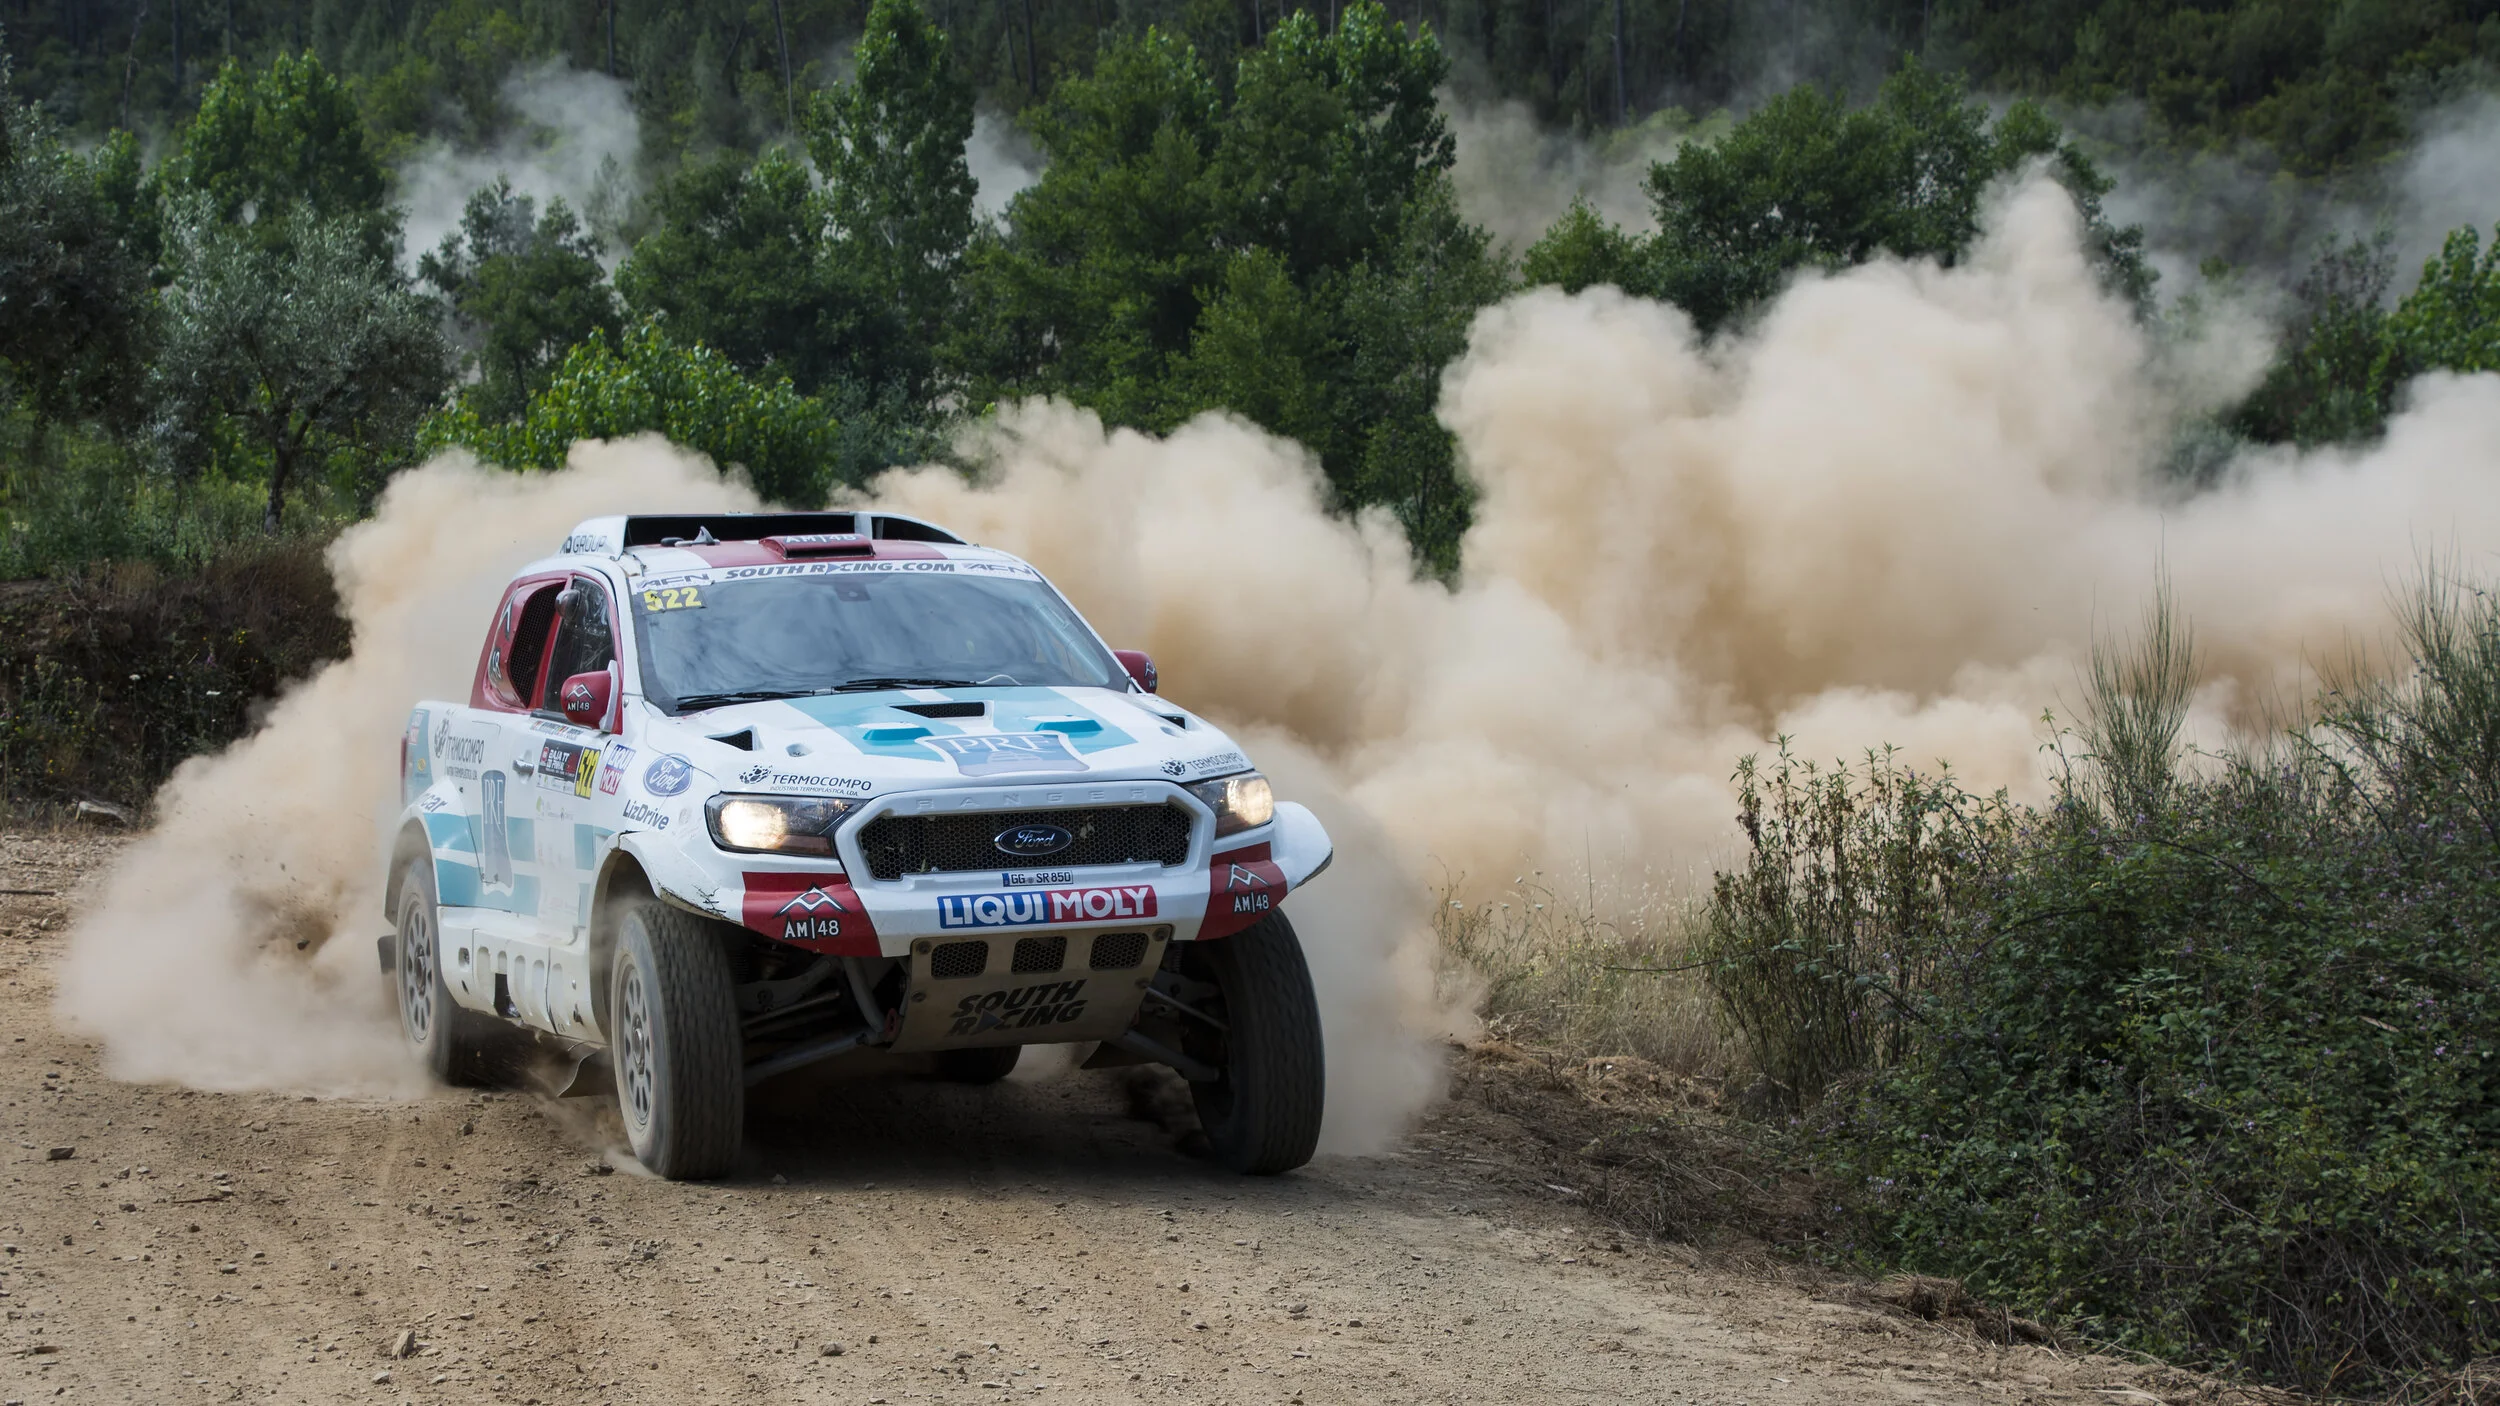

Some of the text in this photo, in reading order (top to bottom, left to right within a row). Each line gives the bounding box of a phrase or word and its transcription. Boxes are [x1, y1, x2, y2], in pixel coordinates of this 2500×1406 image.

[573, 535, 607, 552] GROUP
[725, 565, 803, 579] SOUTH
[643, 586, 702, 612] 522
[607, 746, 635, 770] LIQUI
[1186, 752, 1244, 770] TERMOCOMPO
[576, 748, 600, 798] 522
[601, 768, 622, 794] MOLY
[649, 758, 686, 791] Ford
[772, 774, 872, 791] TERMOCOMPO
[916, 788, 1148, 810] RANGER
[623, 799, 670, 830] LizDrive
[1014, 829, 1056, 849] Ford
[1011, 873, 1026, 884] GG
[943, 887, 1149, 926] LIQUI MOLY
[949, 978, 1088, 1018] SOUTH
